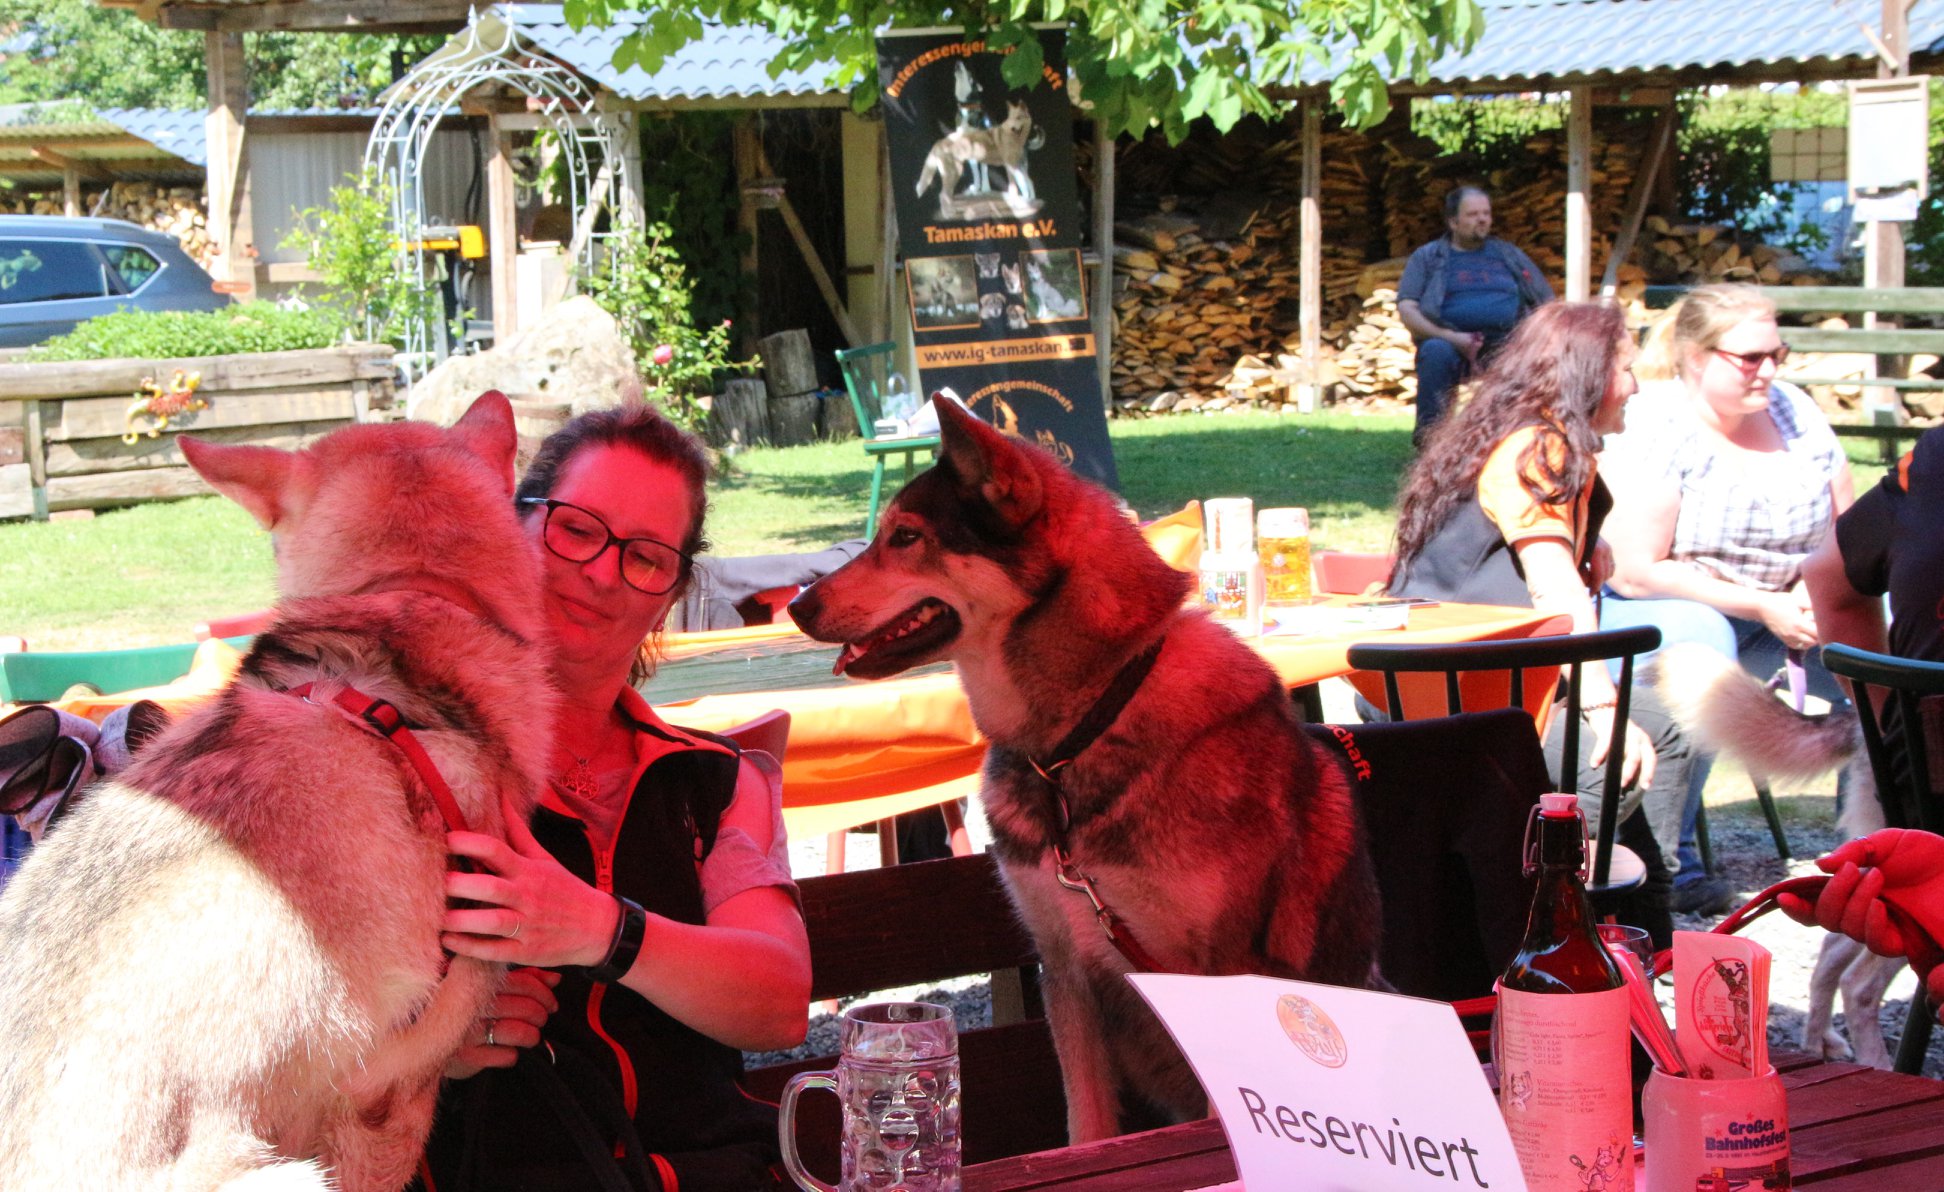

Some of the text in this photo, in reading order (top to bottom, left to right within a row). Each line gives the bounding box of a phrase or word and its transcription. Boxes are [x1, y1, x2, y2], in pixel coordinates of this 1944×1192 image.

[923, 219, 1057, 243] Tamaskan e.V.
[1238, 1086, 1489, 1190] Reserviert
[1728, 1119, 1774, 1136] Großes
